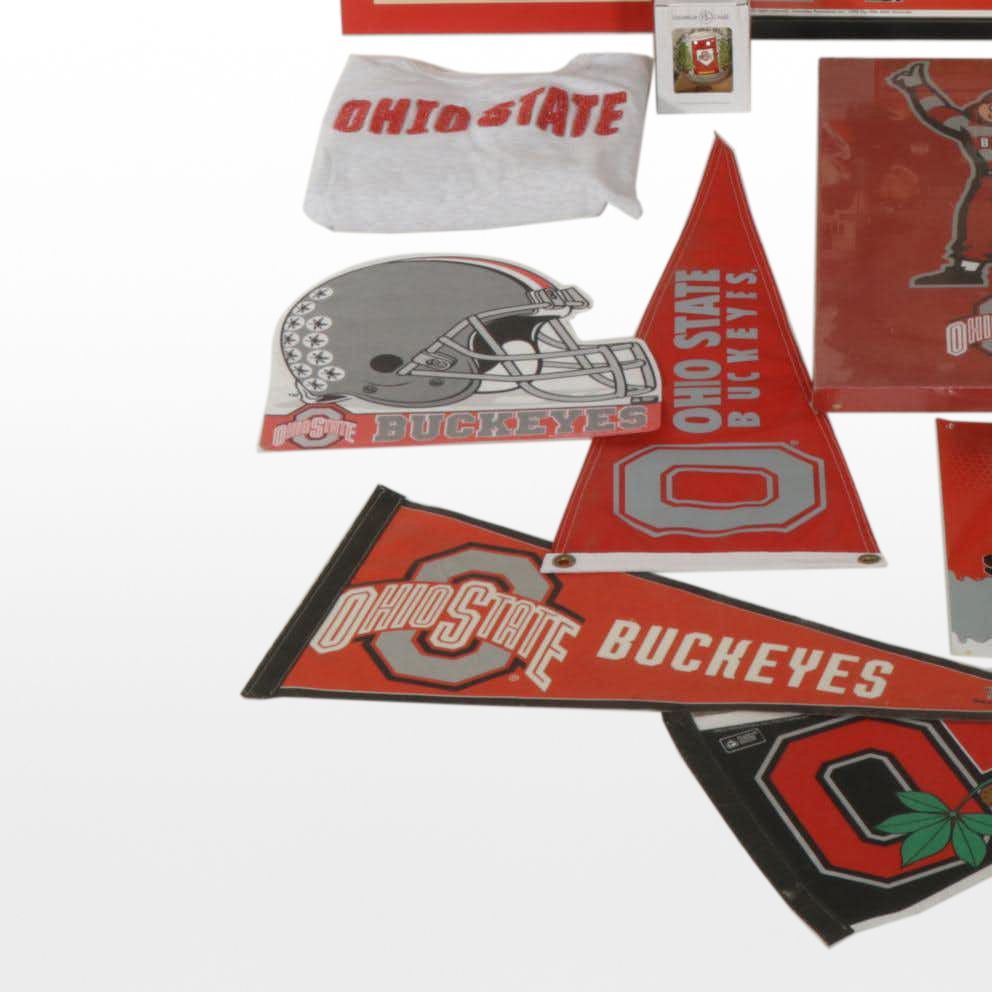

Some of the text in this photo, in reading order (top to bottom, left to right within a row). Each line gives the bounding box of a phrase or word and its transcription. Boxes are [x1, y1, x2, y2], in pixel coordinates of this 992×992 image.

[333, 85, 628, 138] OHIO STATE
[673, 269, 723, 434] OHIO STATE
[725, 272, 761, 429] BUCKEYES
[371, 405, 649, 444] BUCKEYES
[309, 579, 581, 692] OHIO STATE
[597, 617, 895, 700] BUCKEYES
